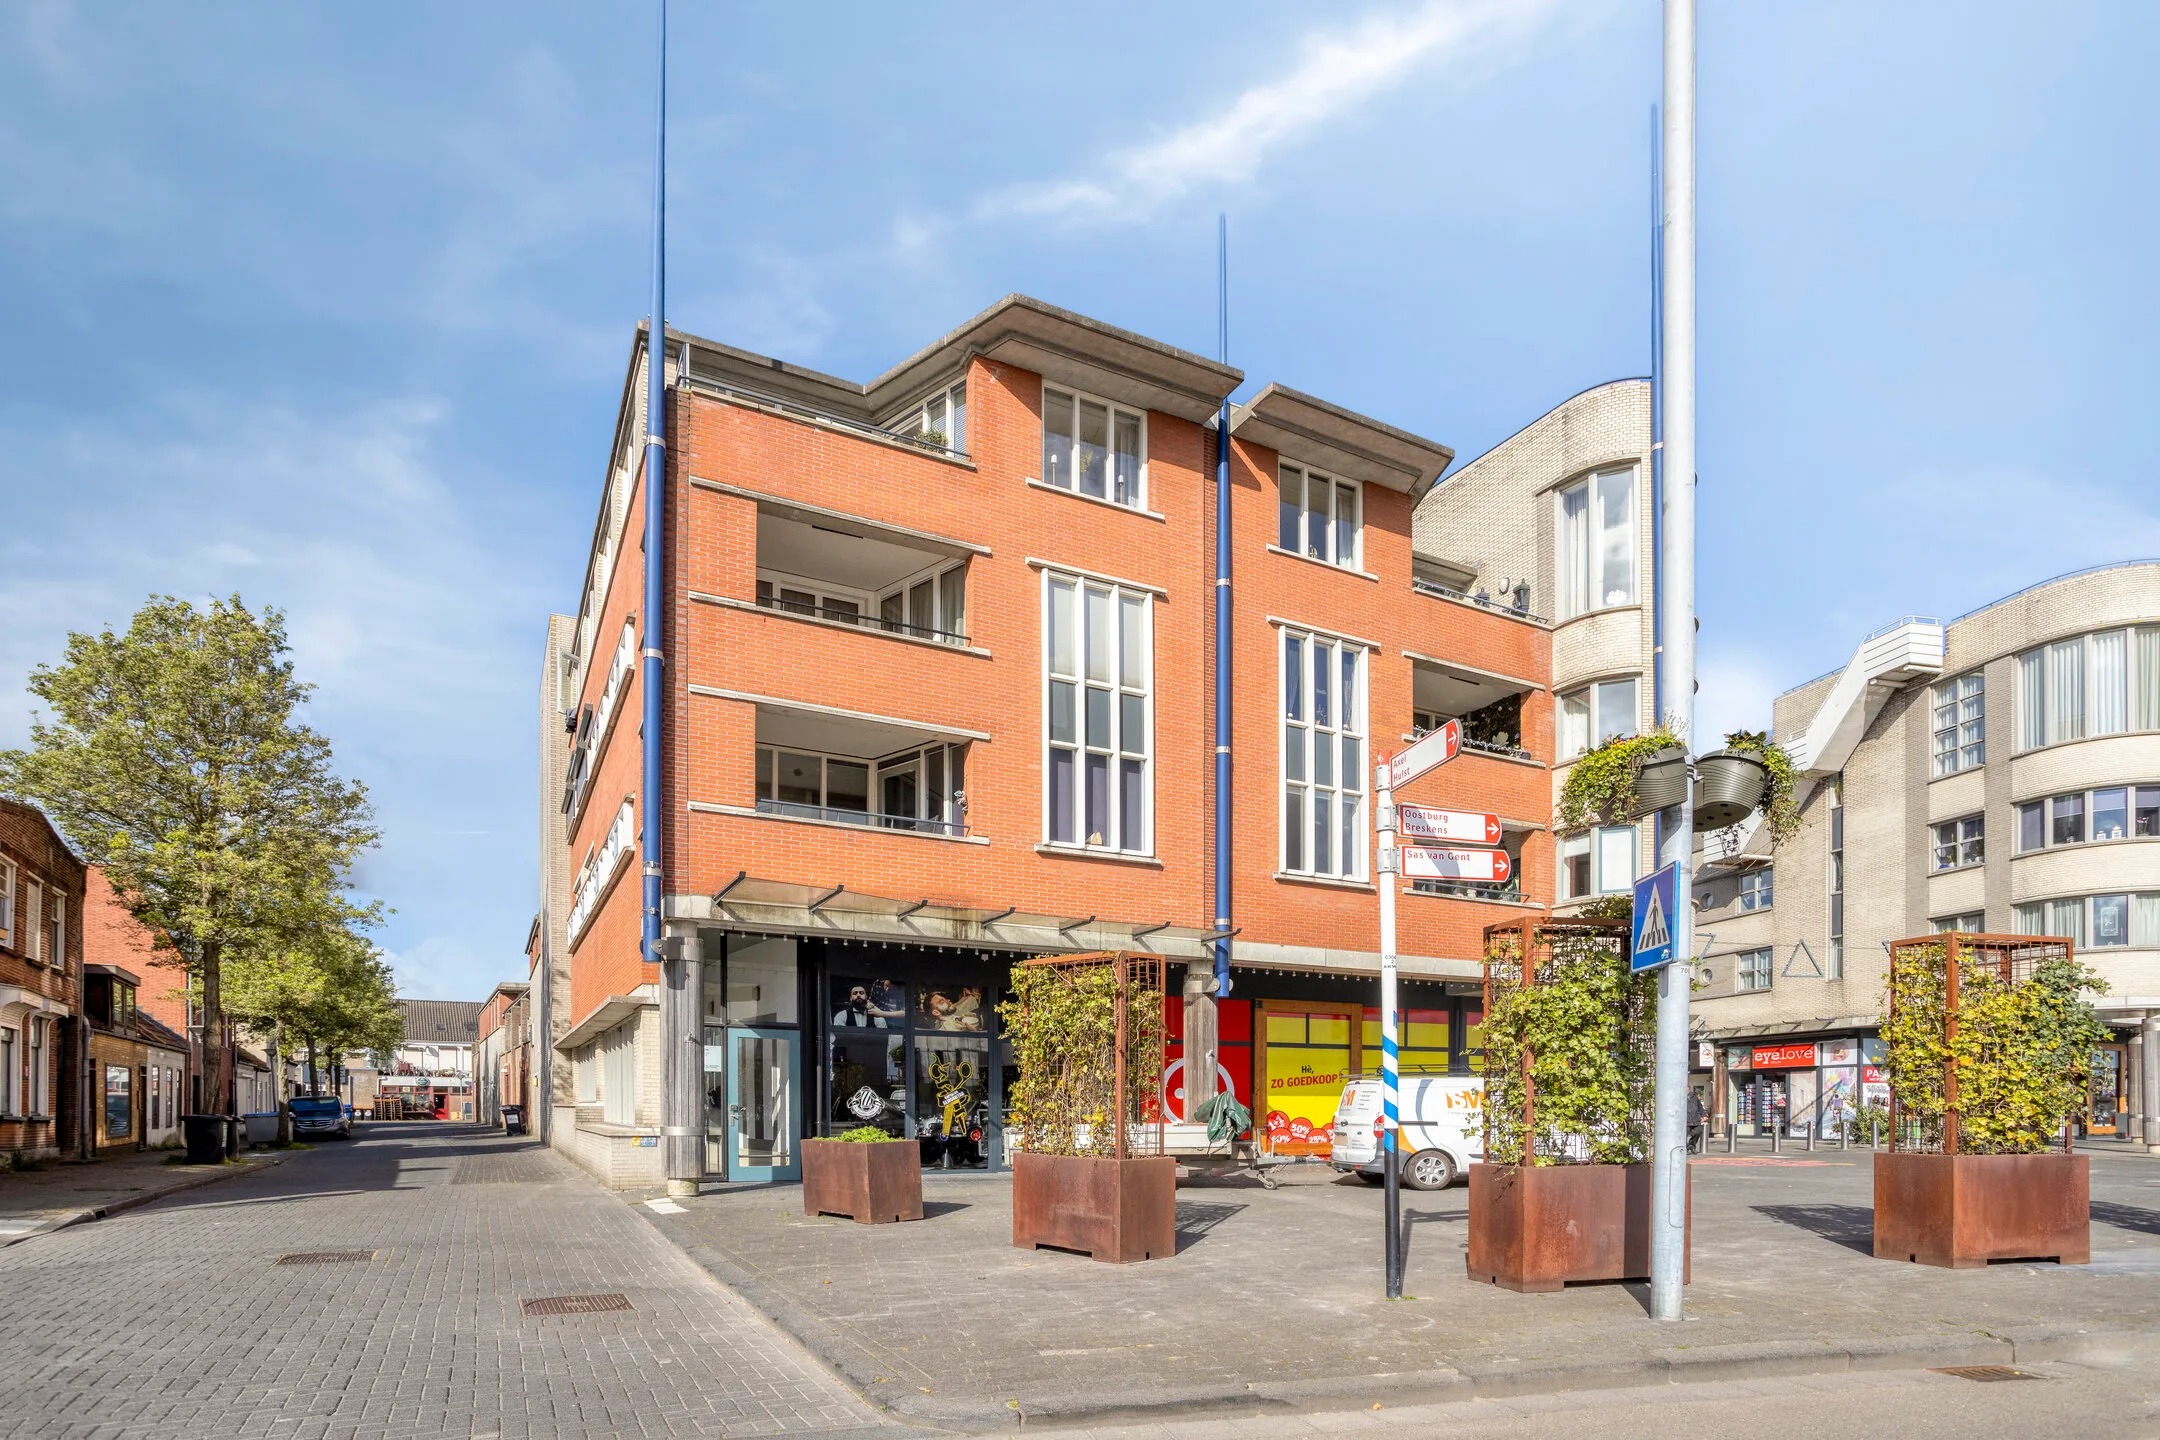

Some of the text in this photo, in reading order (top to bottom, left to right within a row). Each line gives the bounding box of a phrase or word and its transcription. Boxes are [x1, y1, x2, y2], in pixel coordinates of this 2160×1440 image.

[1393, 753, 1407, 768] Axel
[1393, 767, 1410, 783] Hulst
[1405, 809, 1449, 823] Oostburg
[1405, 822, 1448, 834] Breskens
[1407, 850, 1471, 861] Sas van Gent
[1754, 1048, 1813, 1065] eyelove
[1271, 1078, 1284, 1089] ZO
[1291, 1123, 1311, 1135] 50%
[1308, 1135, 1327, 1143] 25%
